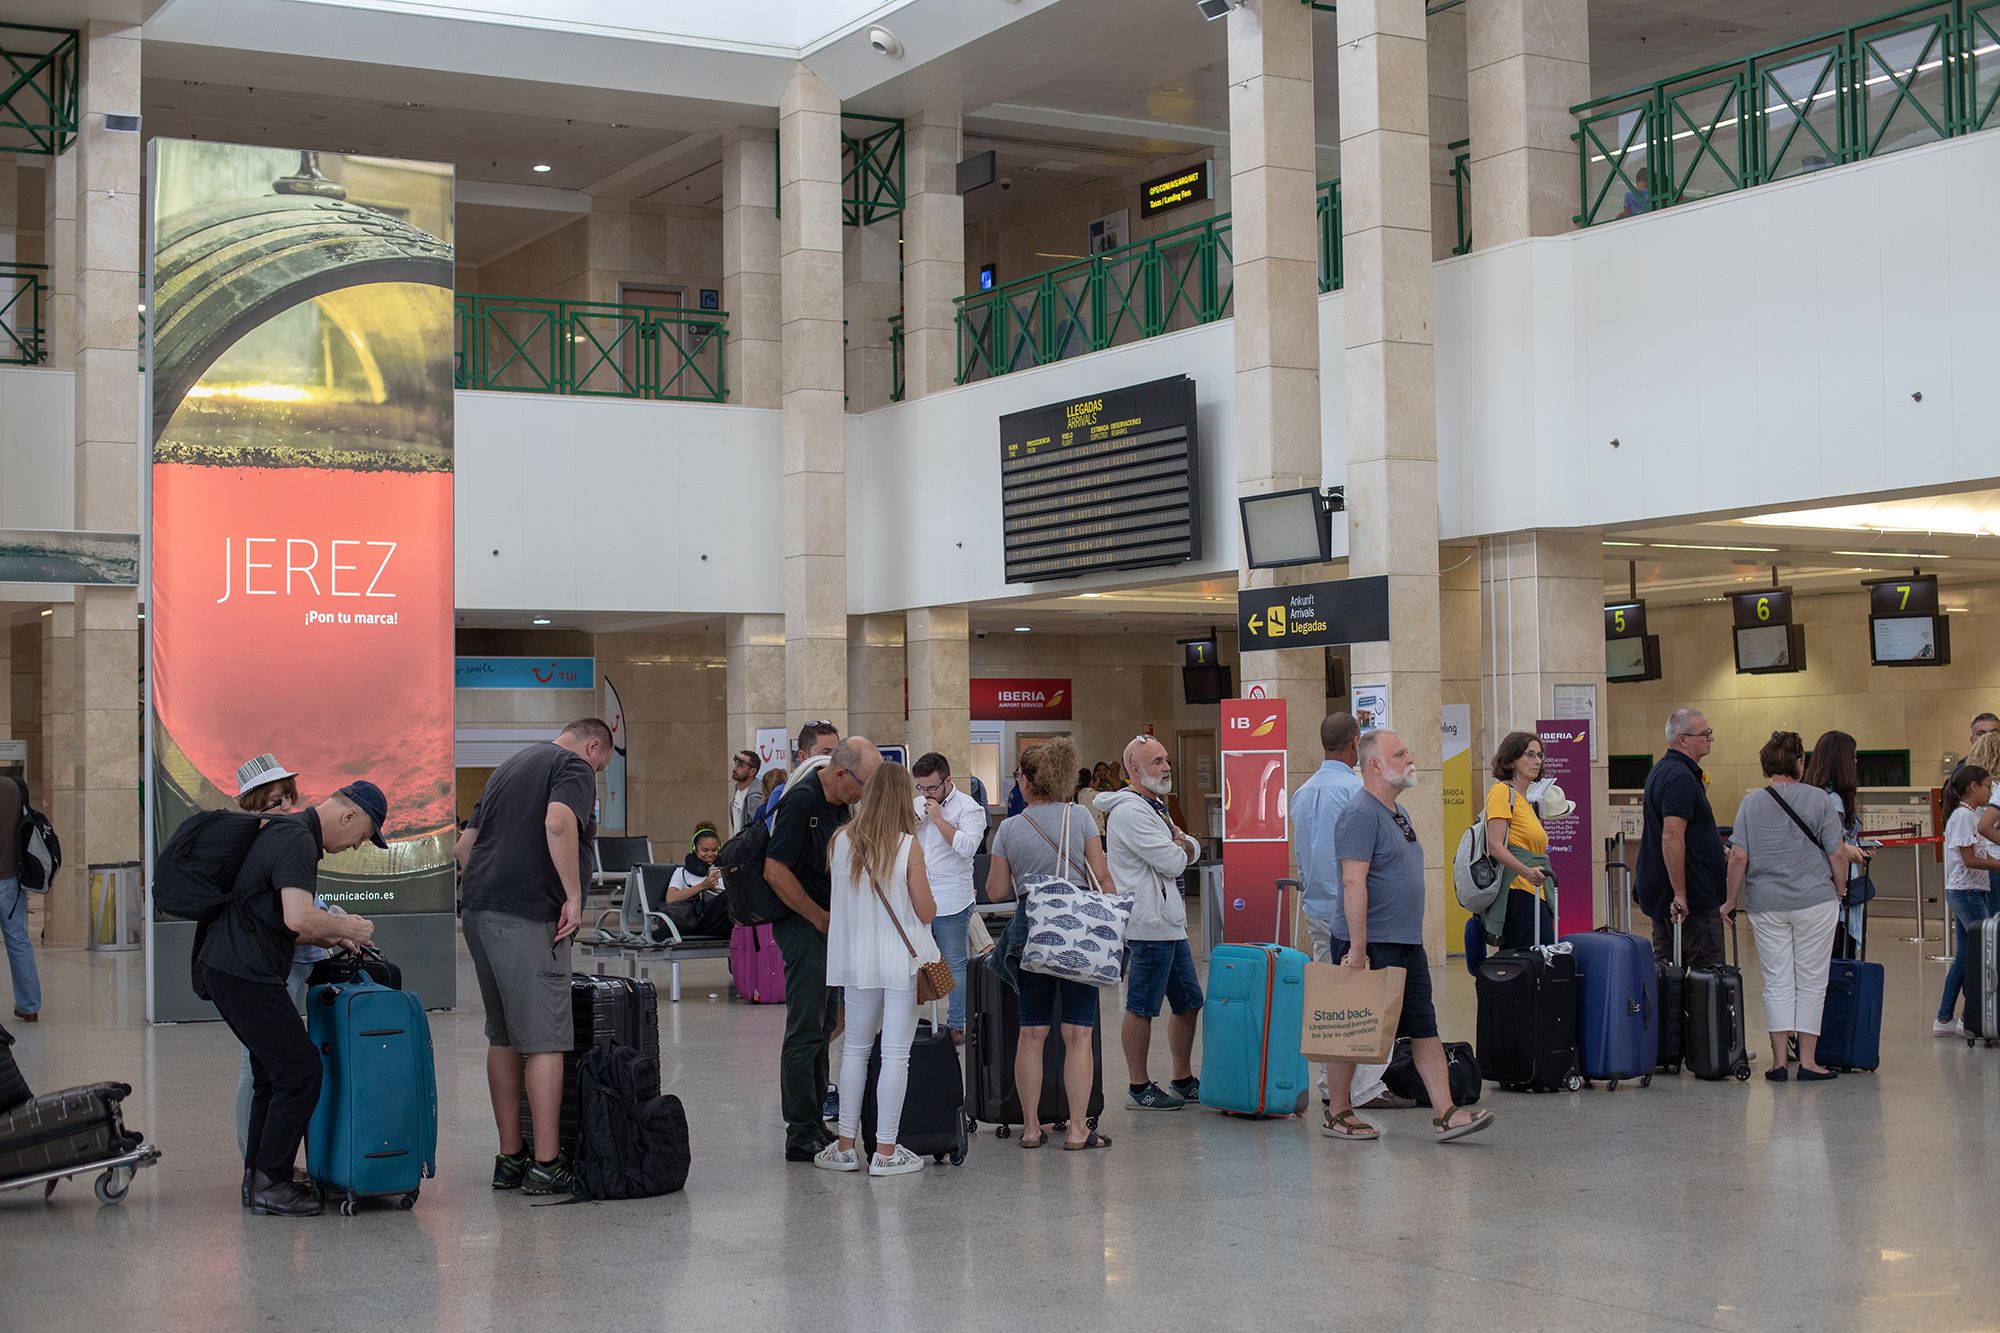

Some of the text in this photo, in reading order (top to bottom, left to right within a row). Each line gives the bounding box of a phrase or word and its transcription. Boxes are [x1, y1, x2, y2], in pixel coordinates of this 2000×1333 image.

[1164, 193, 1181, 204] Landing
[1181, 190, 1192, 198] Fees
[1066, 399, 1102, 418] LLEGADAS
[1068, 412, 1098, 430] ARRIVALS
[1110, 417, 1141, 430] OBSERVACIONES
[1091, 432, 1108, 441] EXPECTED
[217, 537, 397, 604] JEREZ
[1290, 594, 1314, 606] Ankunft
[1897, 586, 1910, 610] 7
[1290, 607, 1314, 619] Arrivals
[1757, 598, 1770, 621] 6
[305, 610, 398, 625] ¡Pon tu marca!
[1615, 610, 1626, 633] 5
[1292, 620, 1327, 635] Llegadas
[1197, 646, 1205, 663] 1
[559, 672, 577, 680] TUI
[998, 691, 1045, 701] IBERIA
[1231, 717, 1250, 729] IB
[1441, 722, 1457, 736] eling
[318, 891, 394, 900] omunicacion.es
[1314, 1008, 1372, 1021] Stand back.
[1310, 1018, 1378, 1030] Unprovoked jumping
[1343, 1026, 1376, 1038] operation!
